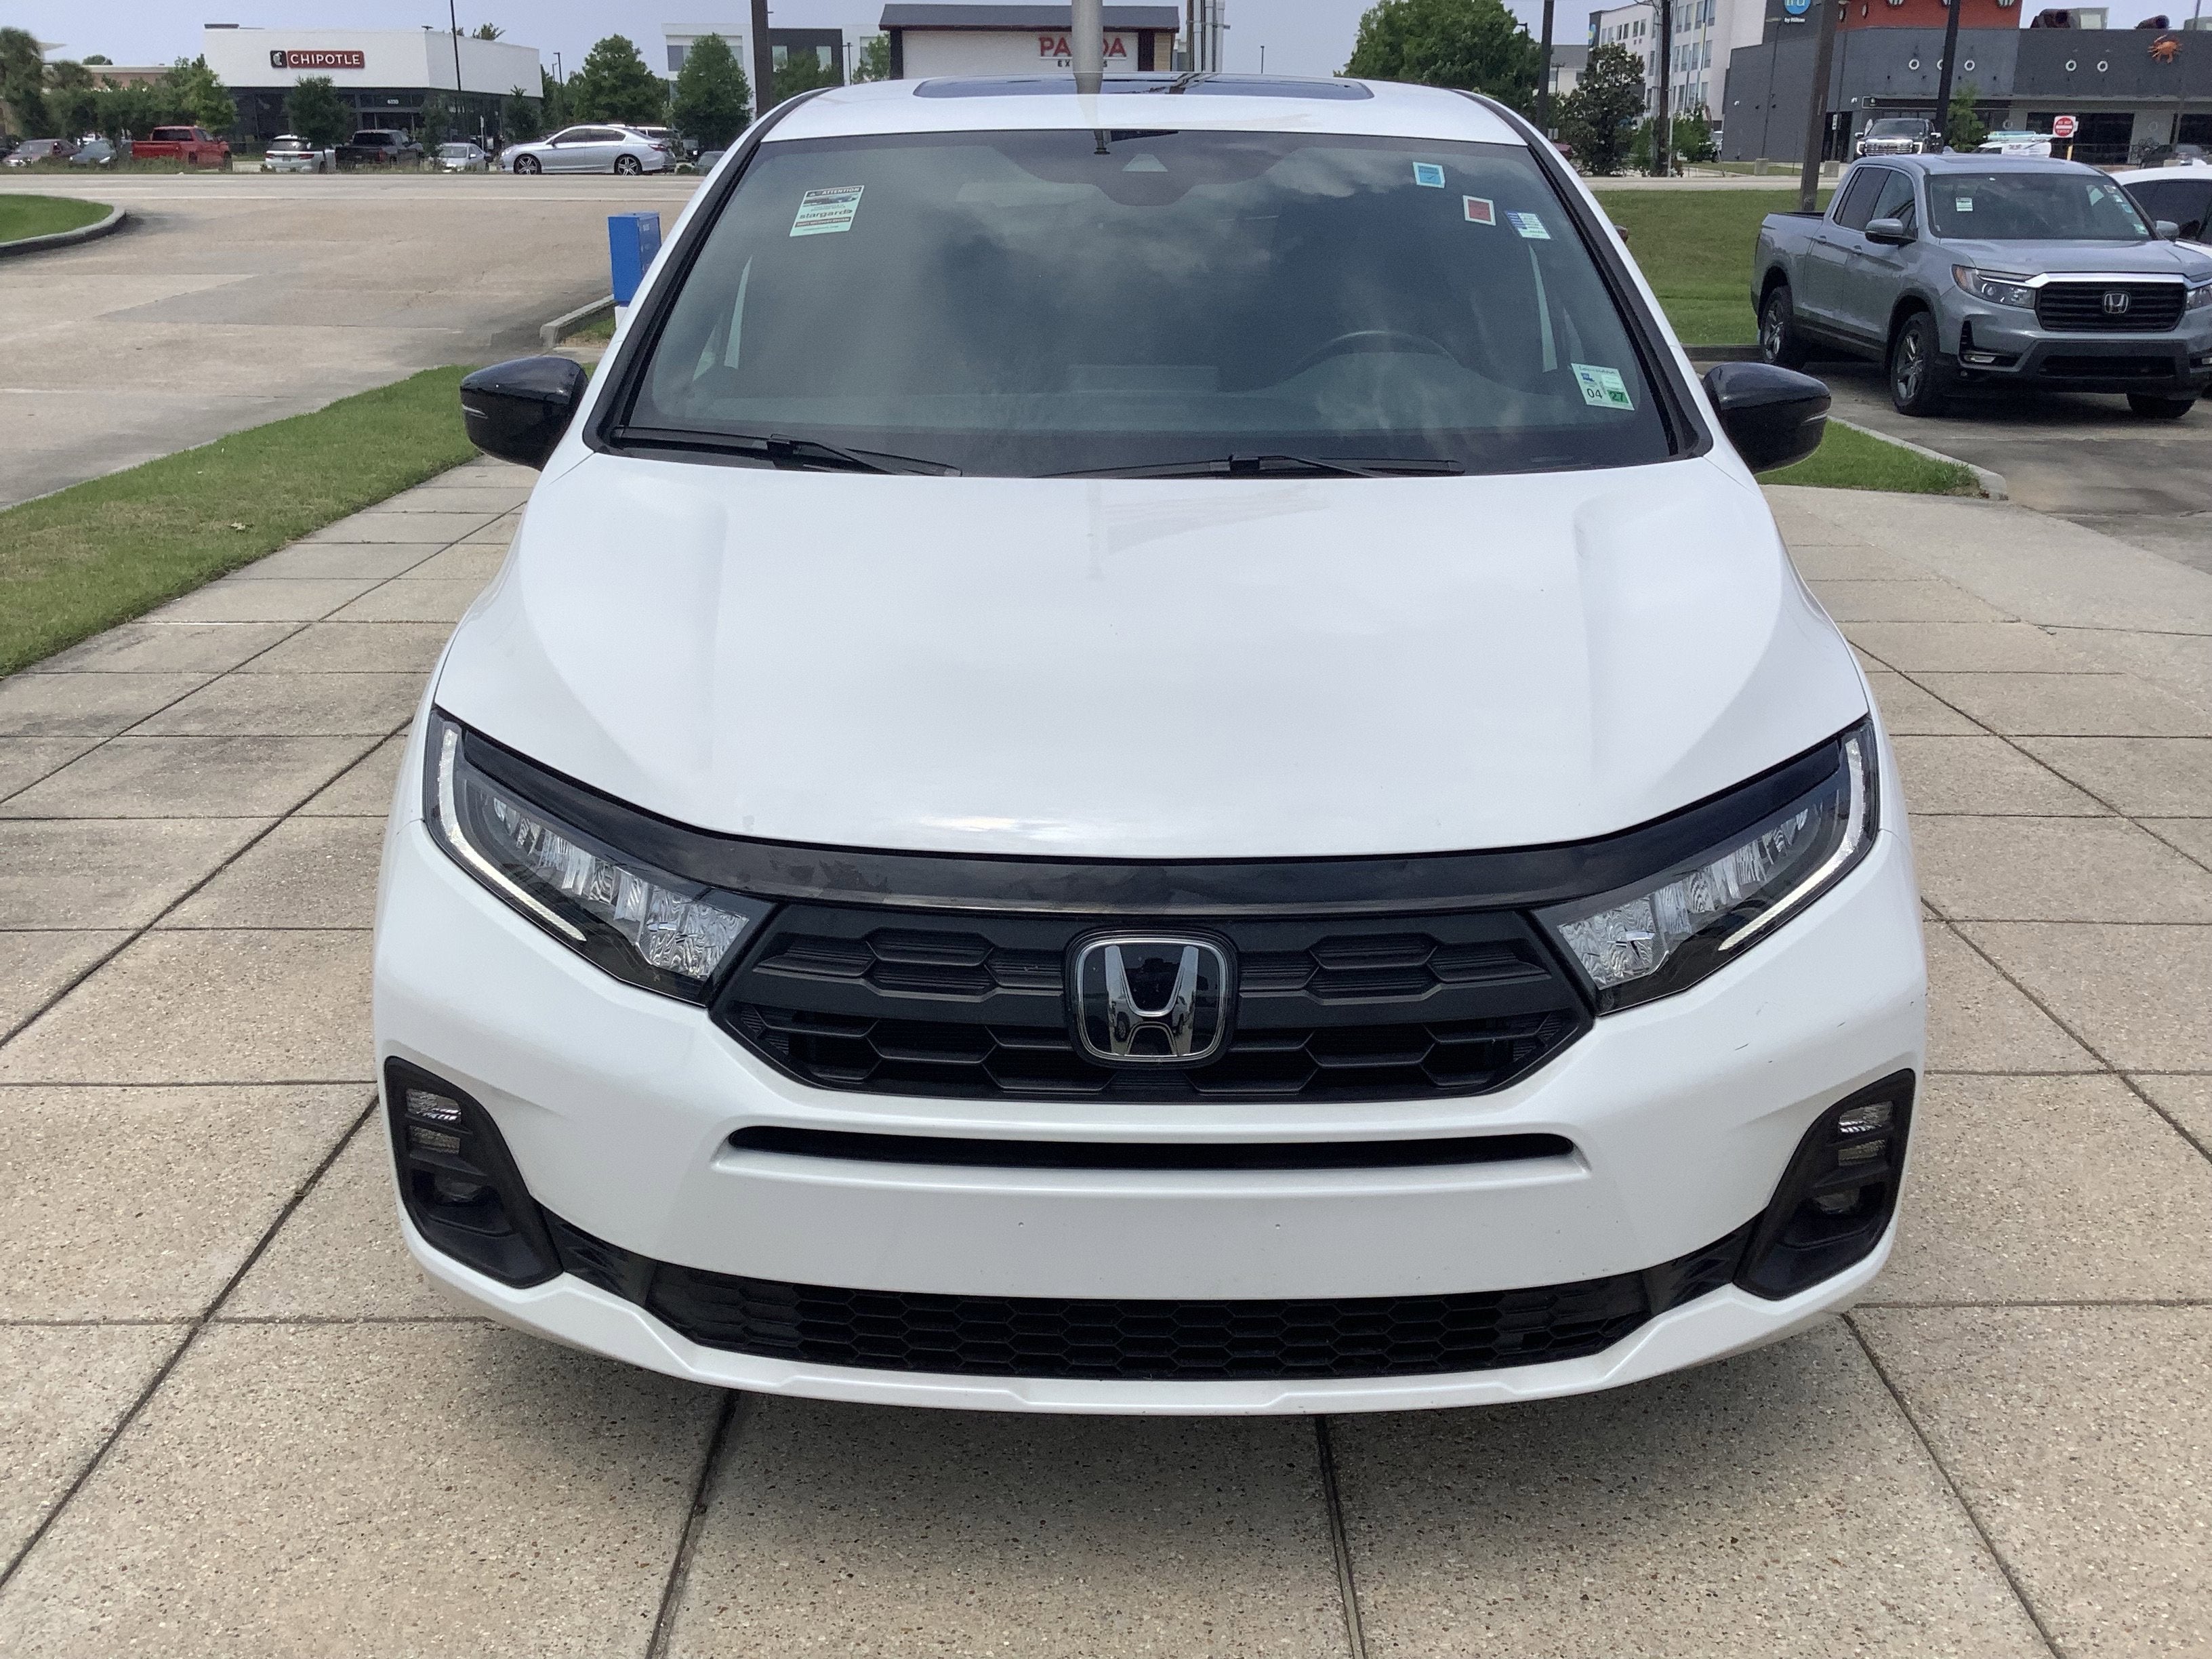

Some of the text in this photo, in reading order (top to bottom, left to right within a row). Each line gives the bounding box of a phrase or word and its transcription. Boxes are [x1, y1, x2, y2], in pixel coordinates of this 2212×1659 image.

[1039, 37, 1126, 57] PAA
[290, 54, 361, 65] CHIPOTLE
[821, 187, 860, 195] ATTENTION
[1586, 388, 1626, 402] 04 27
